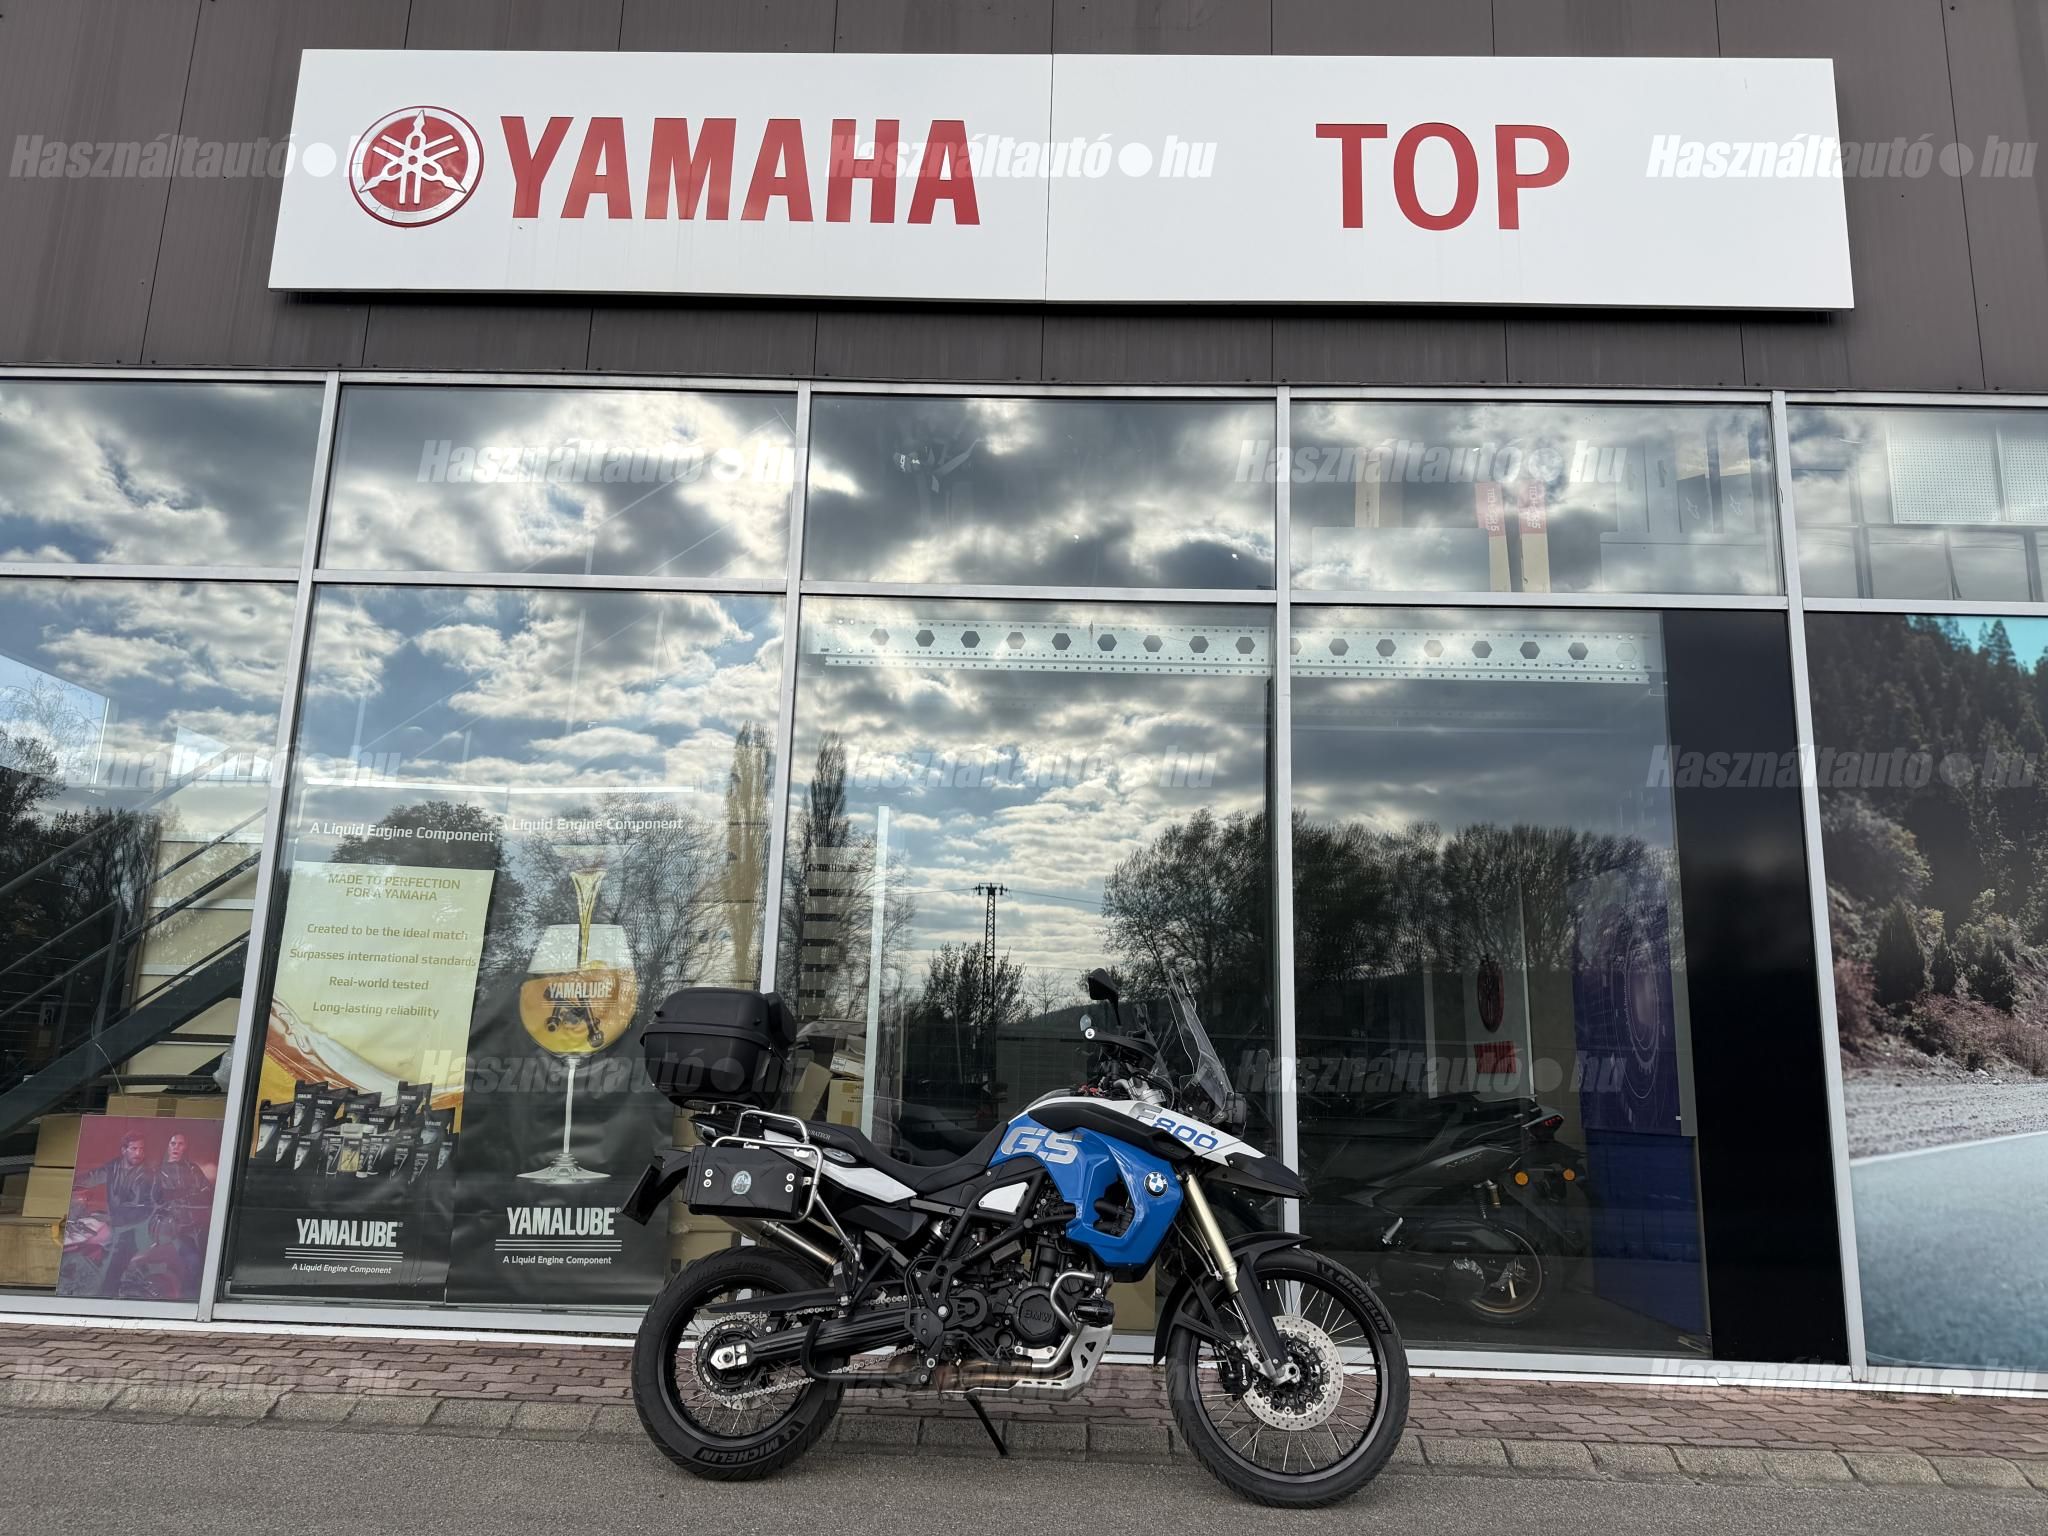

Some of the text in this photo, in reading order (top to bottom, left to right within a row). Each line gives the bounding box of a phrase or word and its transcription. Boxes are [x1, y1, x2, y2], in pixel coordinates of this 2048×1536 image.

[500, 116, 980, 226] YAMAHA
[1315, 122, 1571, 231] TOP
[310, 822, 494, 843] A Liquid Engine Component
[512, 818, 553, 833] Liquid
[557, 818, 602, 833] Engine
[607, 818, 684, 832] Component
[328, 873, 461, 890] MADE TO PERFECTION
[346, 887, 369, 898] FOR
[384, 889, 438, 901] YAMAHA
[307, 923, 468, 941] Created to be the ideal match
[289, 949, 477, 967] Surpasses international standards
[329, 976, 429, 990] Real-world tested
[549, 981, 612, 998] YAMALUBE
[313, 1002, 440, 1019] Long-lasting reliability
[1001, 1126, 1081, 1164] GS
[506, 1207, 616, 1236] YAMALUBE
[296, 1218, 398, 1248] YAMALUBE
[291, 1263, 392, 1275] A Liquid Engine Component
[502, 1255, 612, 1266] A Liquid Engine Component
[1336, 1275, 1390, 1331] MICHELIN
[699, 1438, 780, 1463] MICHELIN
